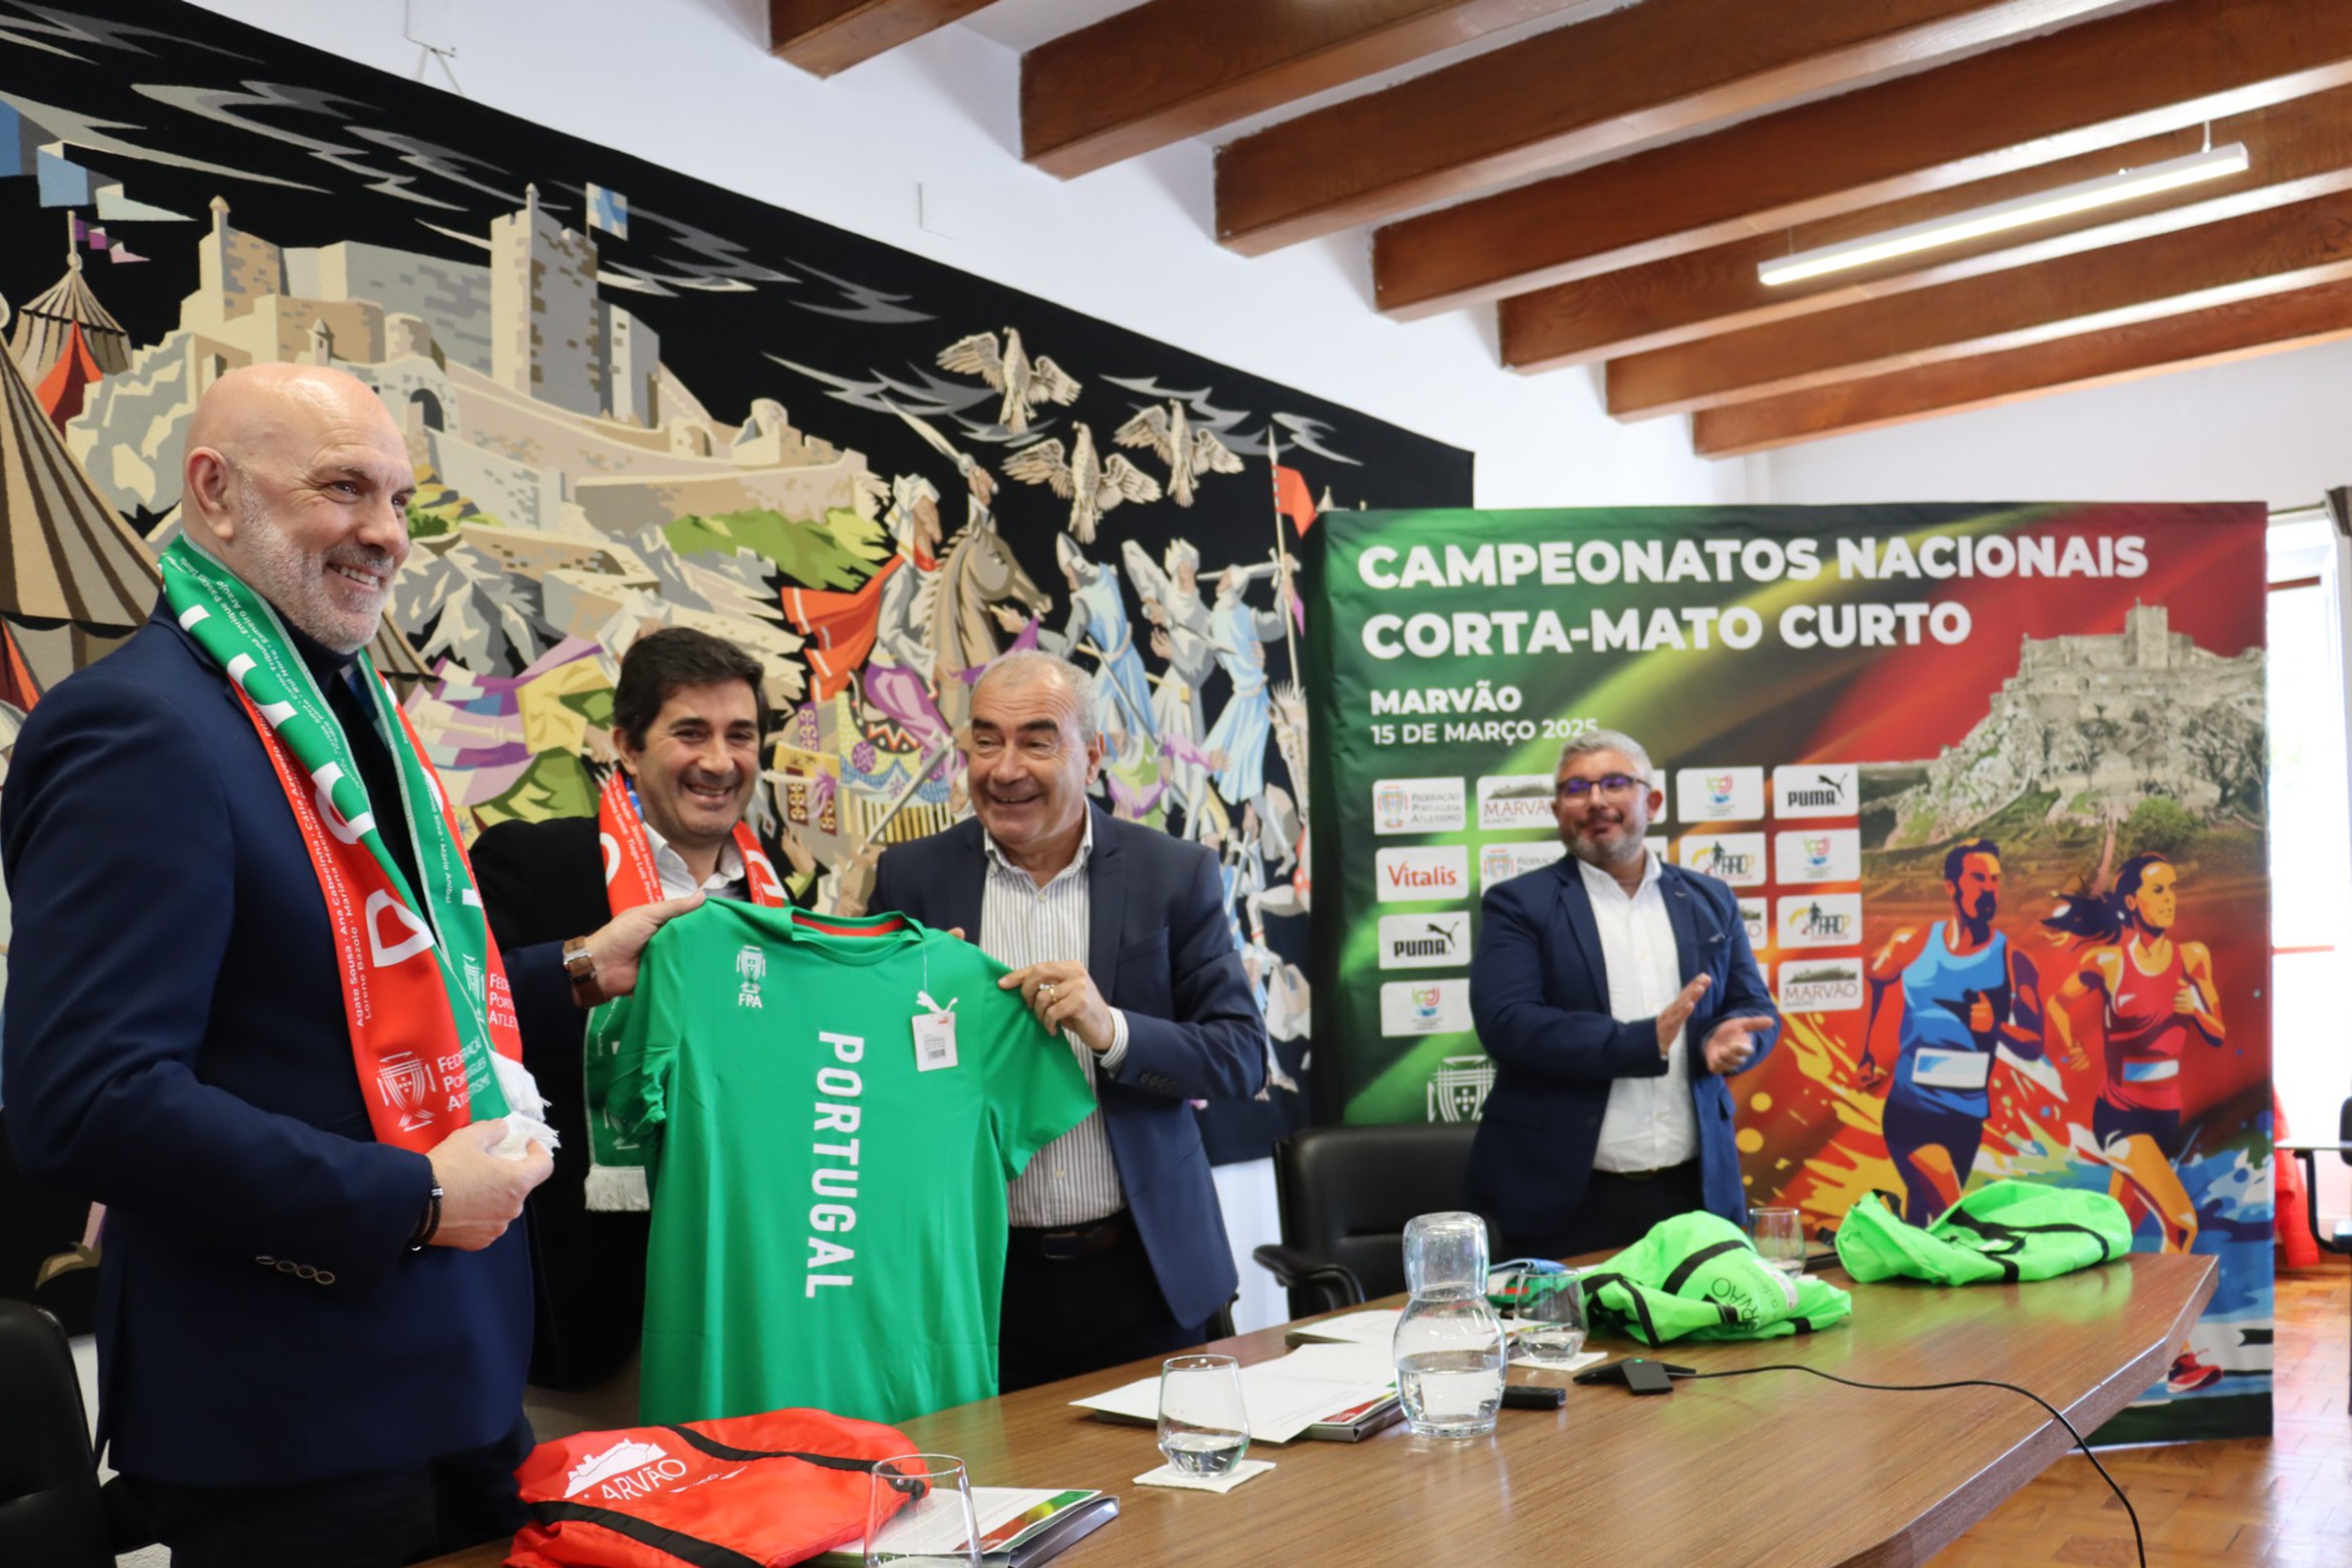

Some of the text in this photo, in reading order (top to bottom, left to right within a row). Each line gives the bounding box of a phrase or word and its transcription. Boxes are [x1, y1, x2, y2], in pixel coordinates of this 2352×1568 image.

[1358, 535, 2149, 589] CAMPEONATOS NACIONAIS
[221, 603, 249, 635] Enrique
[1362, 601, 1972, 660] CORTA-MATO CURTO
[1370, 680, 1521, 716] MARVÃO
[1371, 717, 1598, 747] 15 DE MARÇO 2025
[273, 746, 299, 796] Azevedo
[1788, 790, 1836, 807] PUMA
[310, 807, 334, 864] Machado
[313, 840, 340, 907] Cabecinha
[331, 860, 353, 917] Mariana
[1388, 861, 1457, 887] Vitalis
[335, 908, 348, 935] Ana
[343, 945, 358, 984] Sousa
[350, 926, 363, 971] Bazolo
[1394, 939, 1447, 958] PUMA
[350, 988, 365, 1027] Agate
[738, 993, 763, 1008] FPA
[1785, 982, 1858, 1001] MARVÃO
[805, 1030, 865, 1299] PORTUGAL
[585, 1458, 687, 1501] ARVÃO
